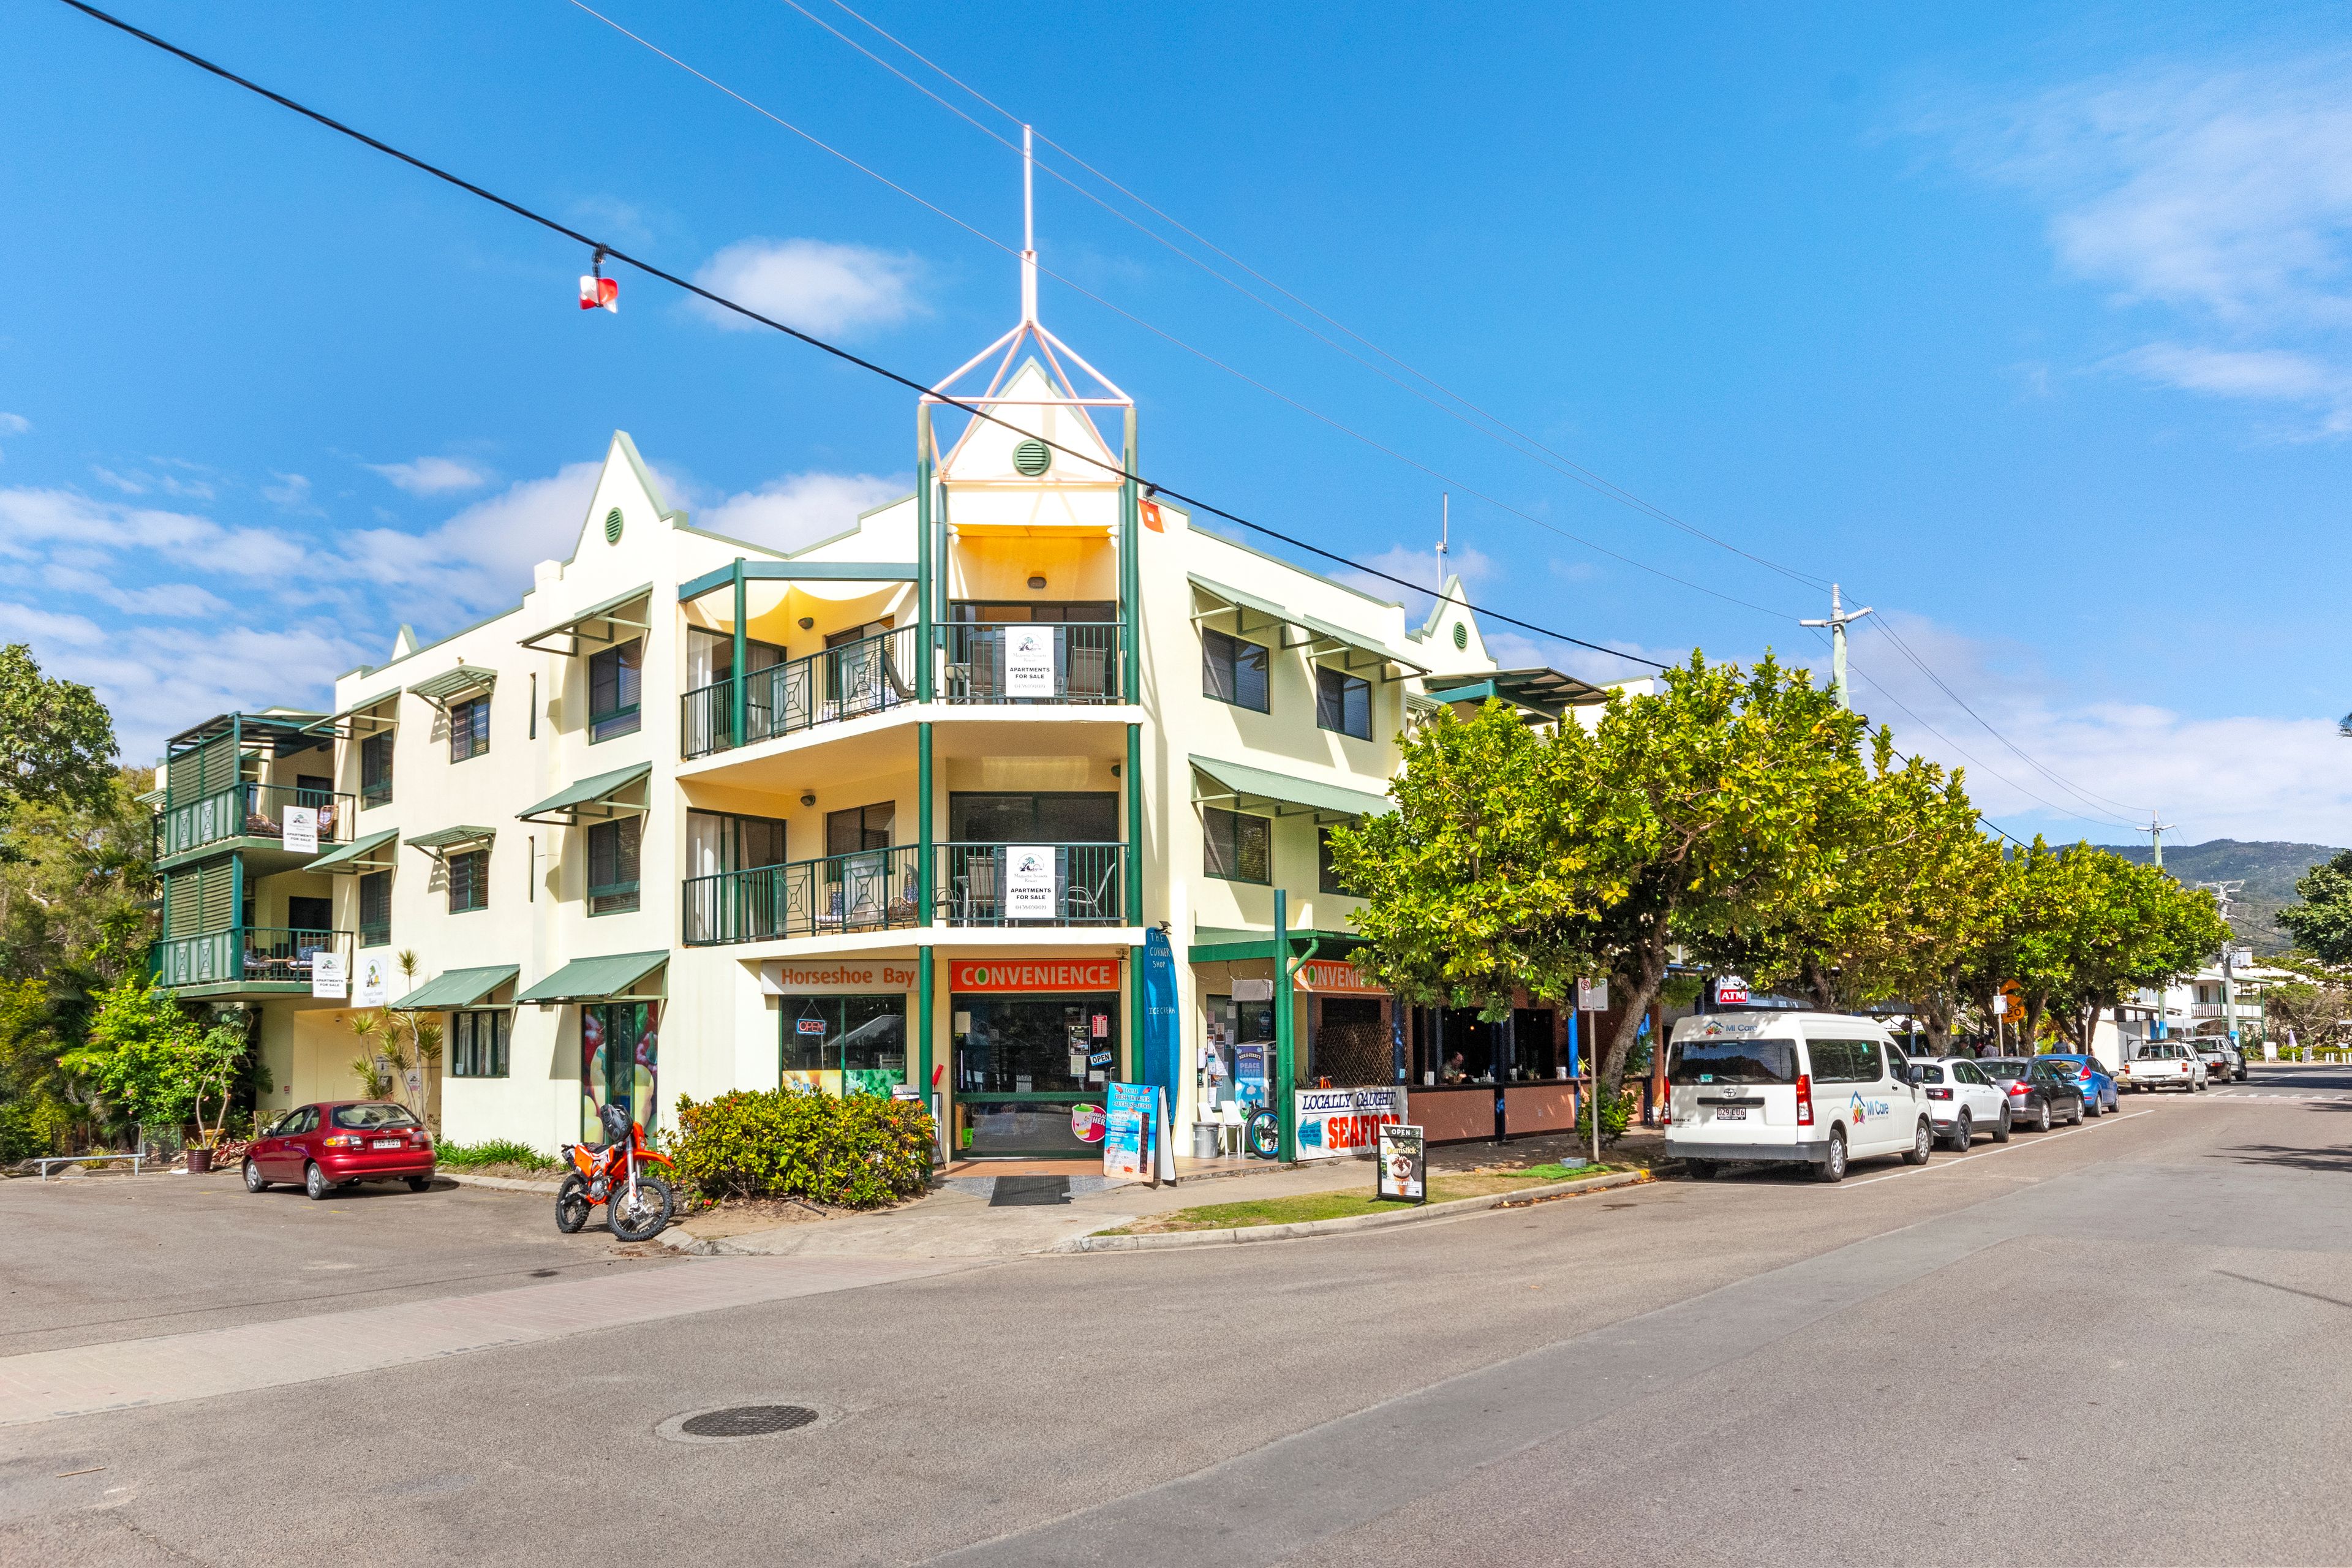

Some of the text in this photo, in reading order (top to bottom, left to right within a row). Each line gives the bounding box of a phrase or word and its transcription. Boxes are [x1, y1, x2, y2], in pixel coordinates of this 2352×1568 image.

[1150, 932, 1164, 942] THE
[1150, 947, 1170, 957] CORNER
[781, 966, 916, 988] Horseshoe Bay
[961, 966, 1110, 986] CONVENIENCE
[2007, 1008, 2021, 1017] 20
[799, 1021, 824, 1032] OPEN
[1092, 1054, 1110, 1063] OPEN
[1302, 1091, 1396, 1110] LOCALLY CAUGHT
[1875, 1100, 1889, 1115] Care
[1092, 1117, 1106, 1126] HER
[1328, 1114, 1401, 1150] SEAFO
[1386, 1146, 1417, 1155] Drumstick
